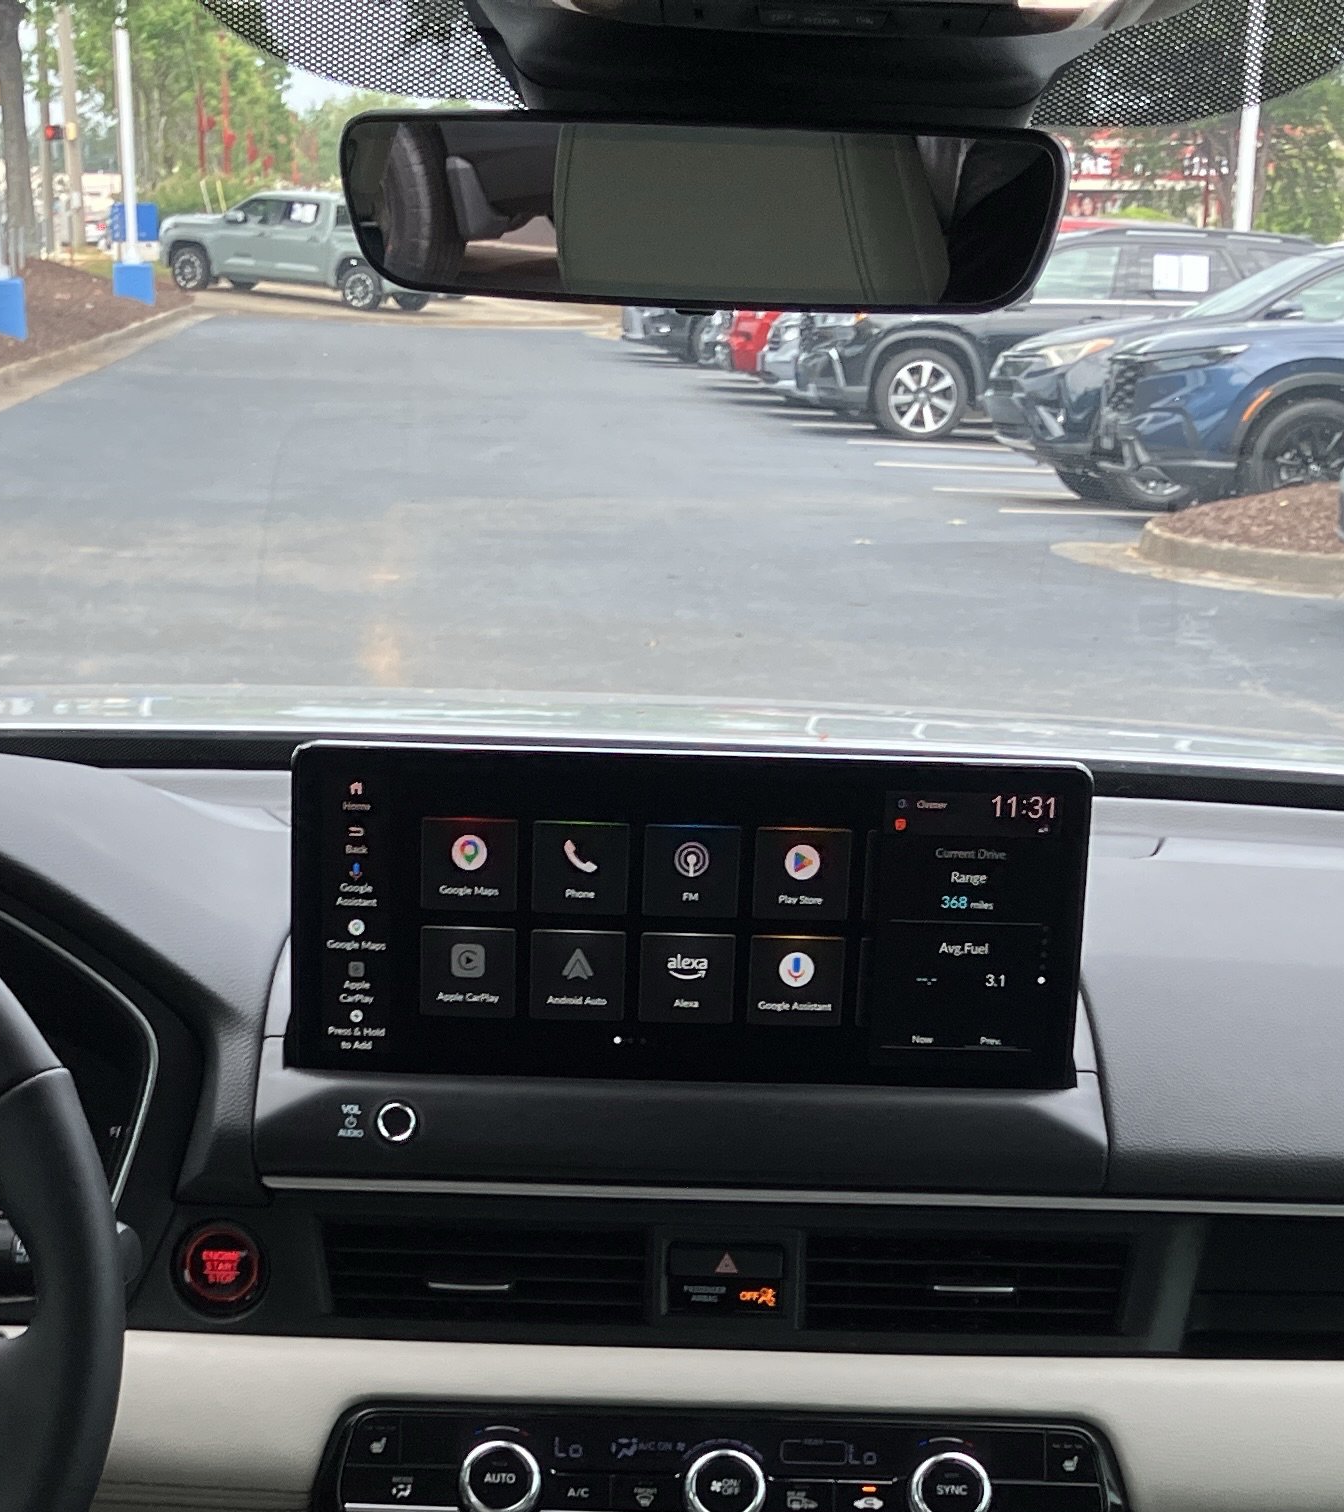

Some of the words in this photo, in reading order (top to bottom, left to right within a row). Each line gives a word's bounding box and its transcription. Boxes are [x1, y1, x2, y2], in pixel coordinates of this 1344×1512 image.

[991, 795, 1056, 819] 11:31
[345, 844, 368, 855] Back
[935, 848, 976, 860] Current
[977, 848, 1006, 860] Drive
[950, 871, 987, 886] Range
[339, 883, 373, 895] Google
[439, 885, 471, 897] Google
[473, 886, 499, 898] Maps
[565, 888, 595, 900] Phone
[336, 896, 377, 908] Assistant
[682, 892, 699, 902] FM
[778, 895, 797, 906] Play
[798, 895, 823, 905] Store
[940, 896, 968, 909] 368
[970, 900, 994, 910] miles
[326, 939, 360, 951] Google
[361, 941, 386, 952] Maps
[667, 953, 708, 970] alexa
[343, 980, 371, 991] Apple
[985, 974, 1005, 988] 3.1
[339, 994, 374, 1005] CarPlay
[436, 991, 464, 1003] Apple
[465, 992, 499, 1004] CarPlay
[546, 995, 581, 1006] Android
[583, 996, 607, 1006] Auto
[673, 998, 699, 1009] Alexa
[758, 1001, 790, 1012] Google
[792, 1001, 832, 1012] Assistant
[328, 1026, 351, 1036] Press
[362, 1027, 386, 1037] Hold
[340, 1040, 352, 1049] to
[353, 1039, 373, 1050] Add
[911, 1034, 934, 1044] Now
[341, 1104, 362, 1115] VOL
[337, 1128, 364, 1139] AUDIO
[205, 1260, 238, 1271] START
[207, 1272, 236, 1284] STOP
[739, 1290, 760, 1301] OFF
[483, 1472, 516, 1486] AUTO
[566, 1486, 591, 1499] A/C
[935, 1483, 969, 1497] SYNC
